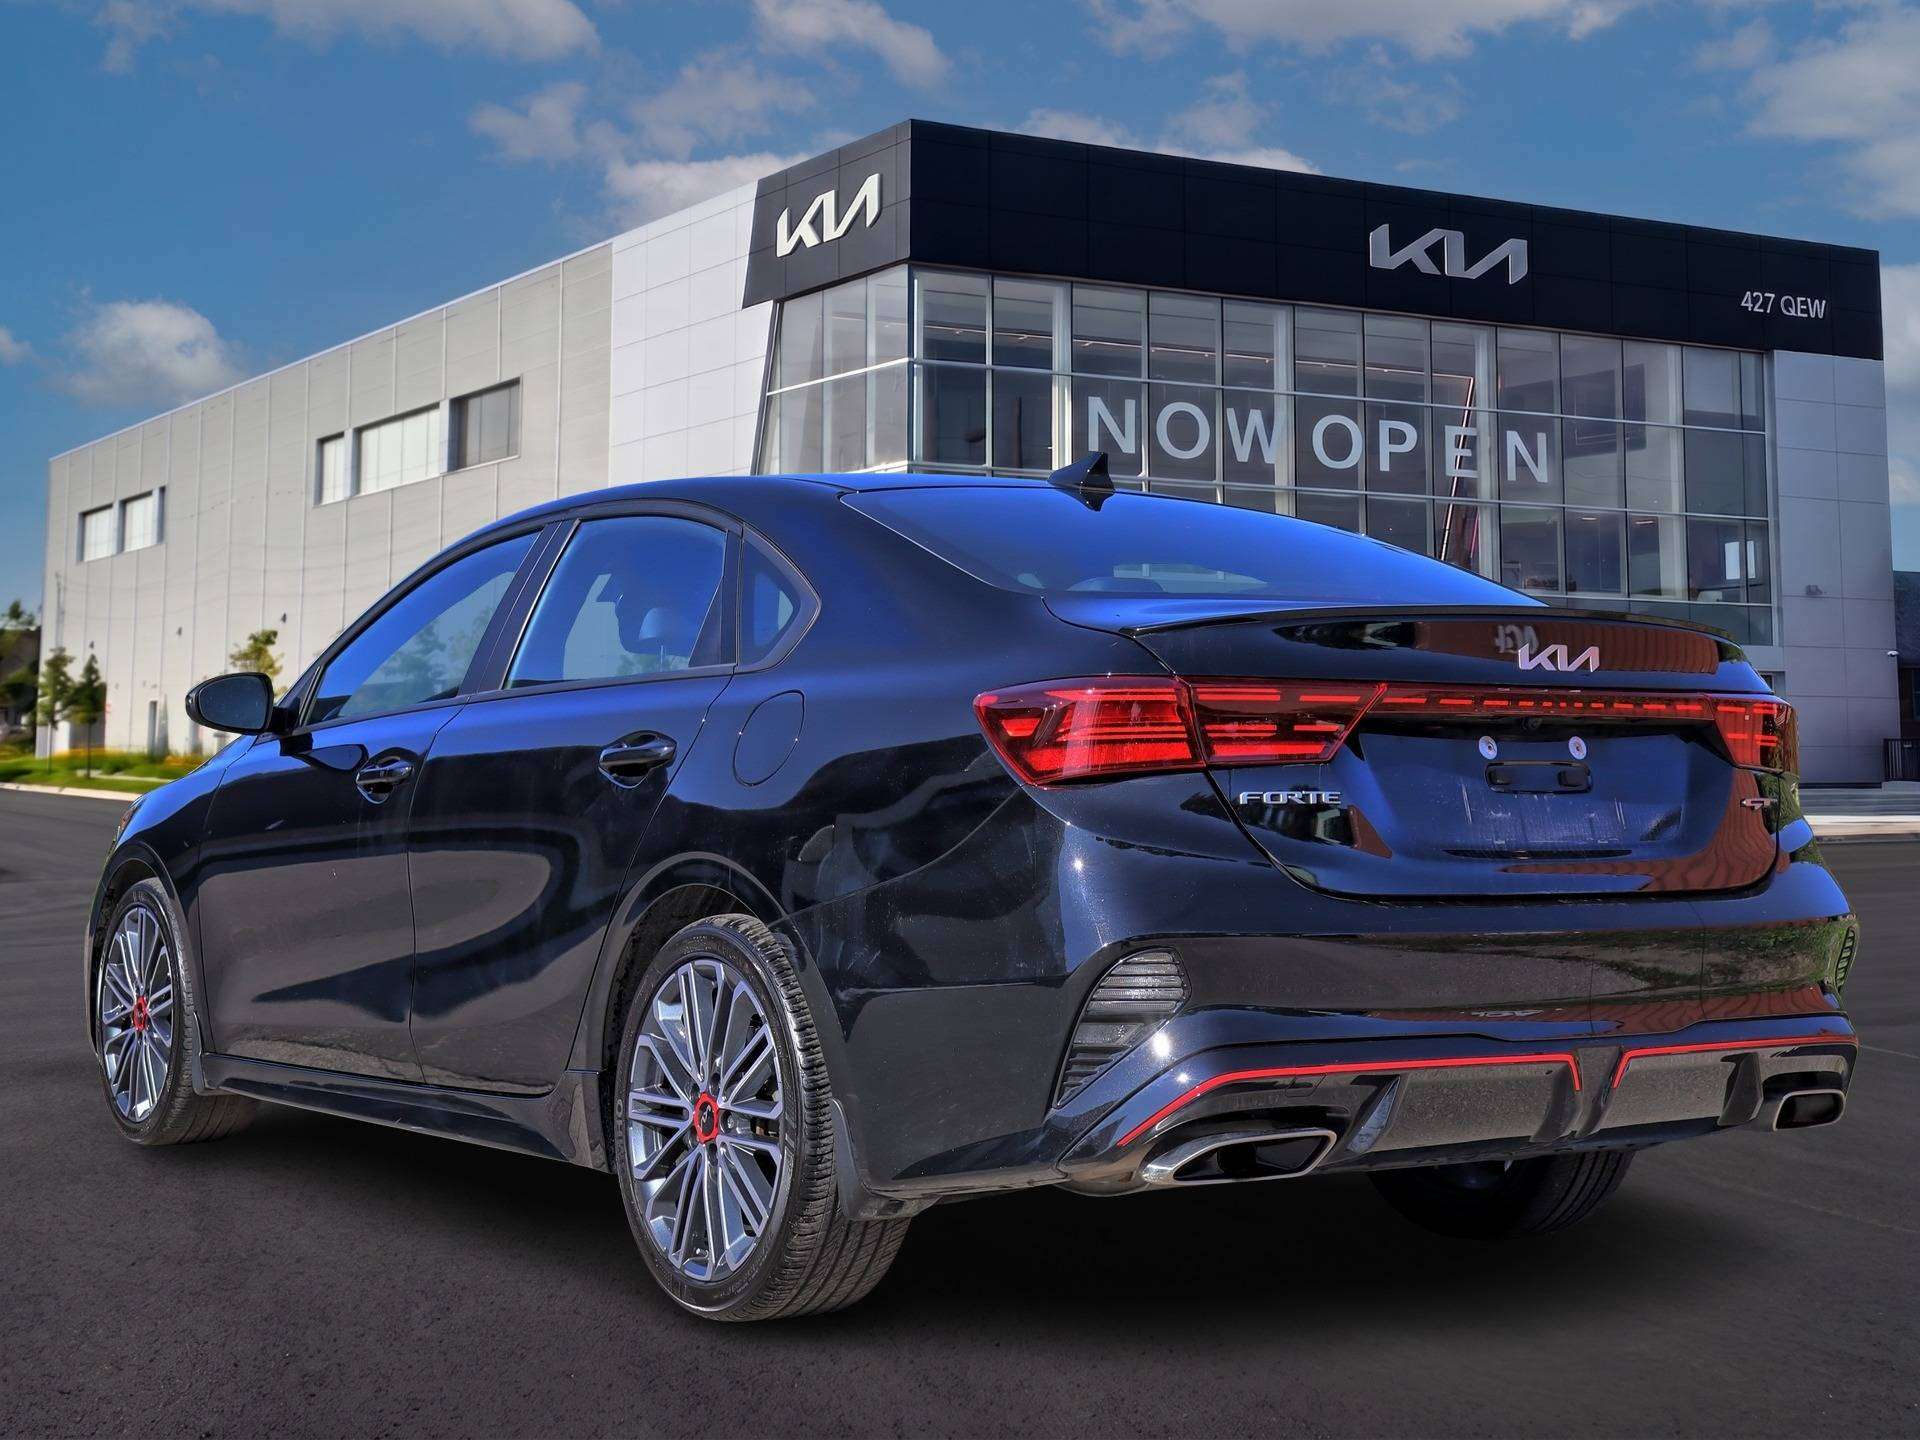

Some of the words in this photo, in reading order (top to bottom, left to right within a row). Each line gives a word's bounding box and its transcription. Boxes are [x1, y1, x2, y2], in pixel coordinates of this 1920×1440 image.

[776, 173, 880, 258] KIA
[1369, 223, 1529, 285] KIA
[1740, 291, 1776, 314] 427
[1780, 295, 1827, 319] QEW
[1087, 396, 1280, 465] NOW
[1312, 414, 1549, 483] OPEN
[1518, 642, 1600, 673] KIA
[1239, 791, 1342, 805] FORTE
